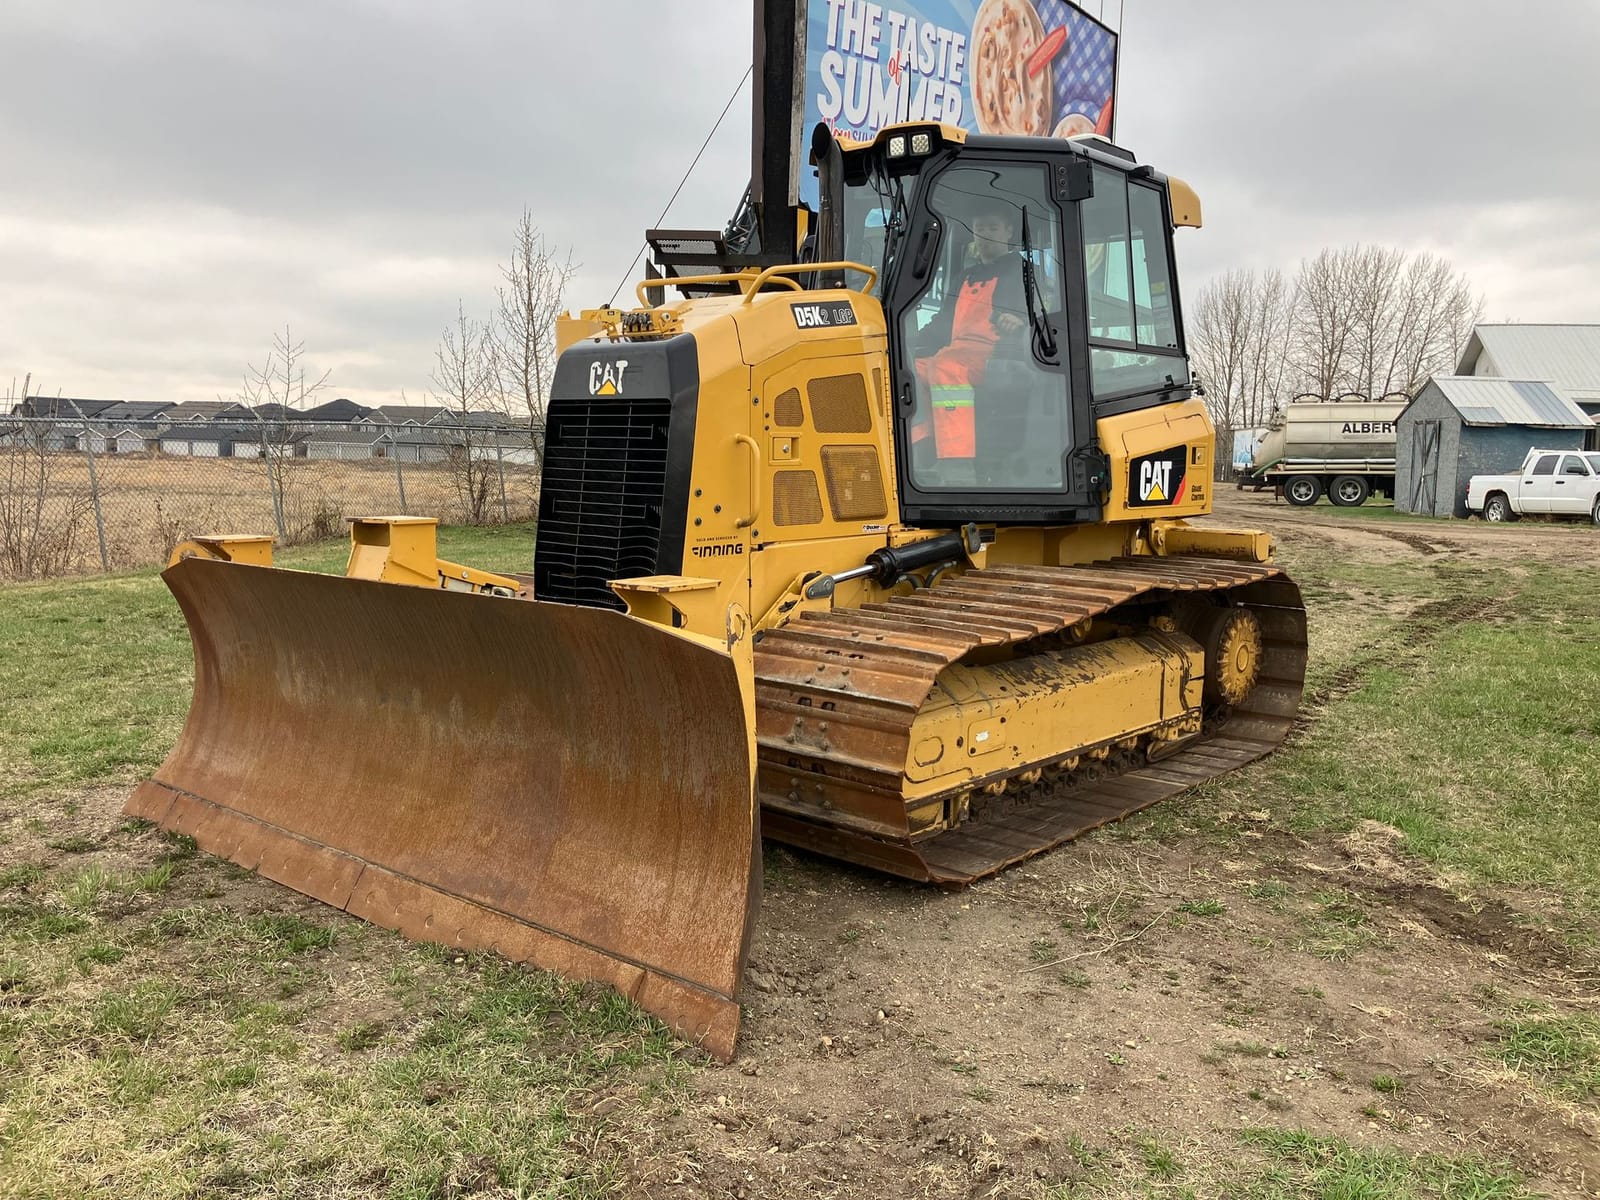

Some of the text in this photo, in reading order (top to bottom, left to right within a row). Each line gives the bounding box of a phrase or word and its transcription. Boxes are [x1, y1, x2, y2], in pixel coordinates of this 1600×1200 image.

[827, 0, 966, 85] THE TASTE
[888, 50, 904, 86] of
[817, 50, 963, 130] SUMMER
[833, 308, 854, 325] LGP
[589, 360, 629, 396] CAT
[1140, 460, 1173, 501] CAT
[692, 543, 743, 558] FINNING
